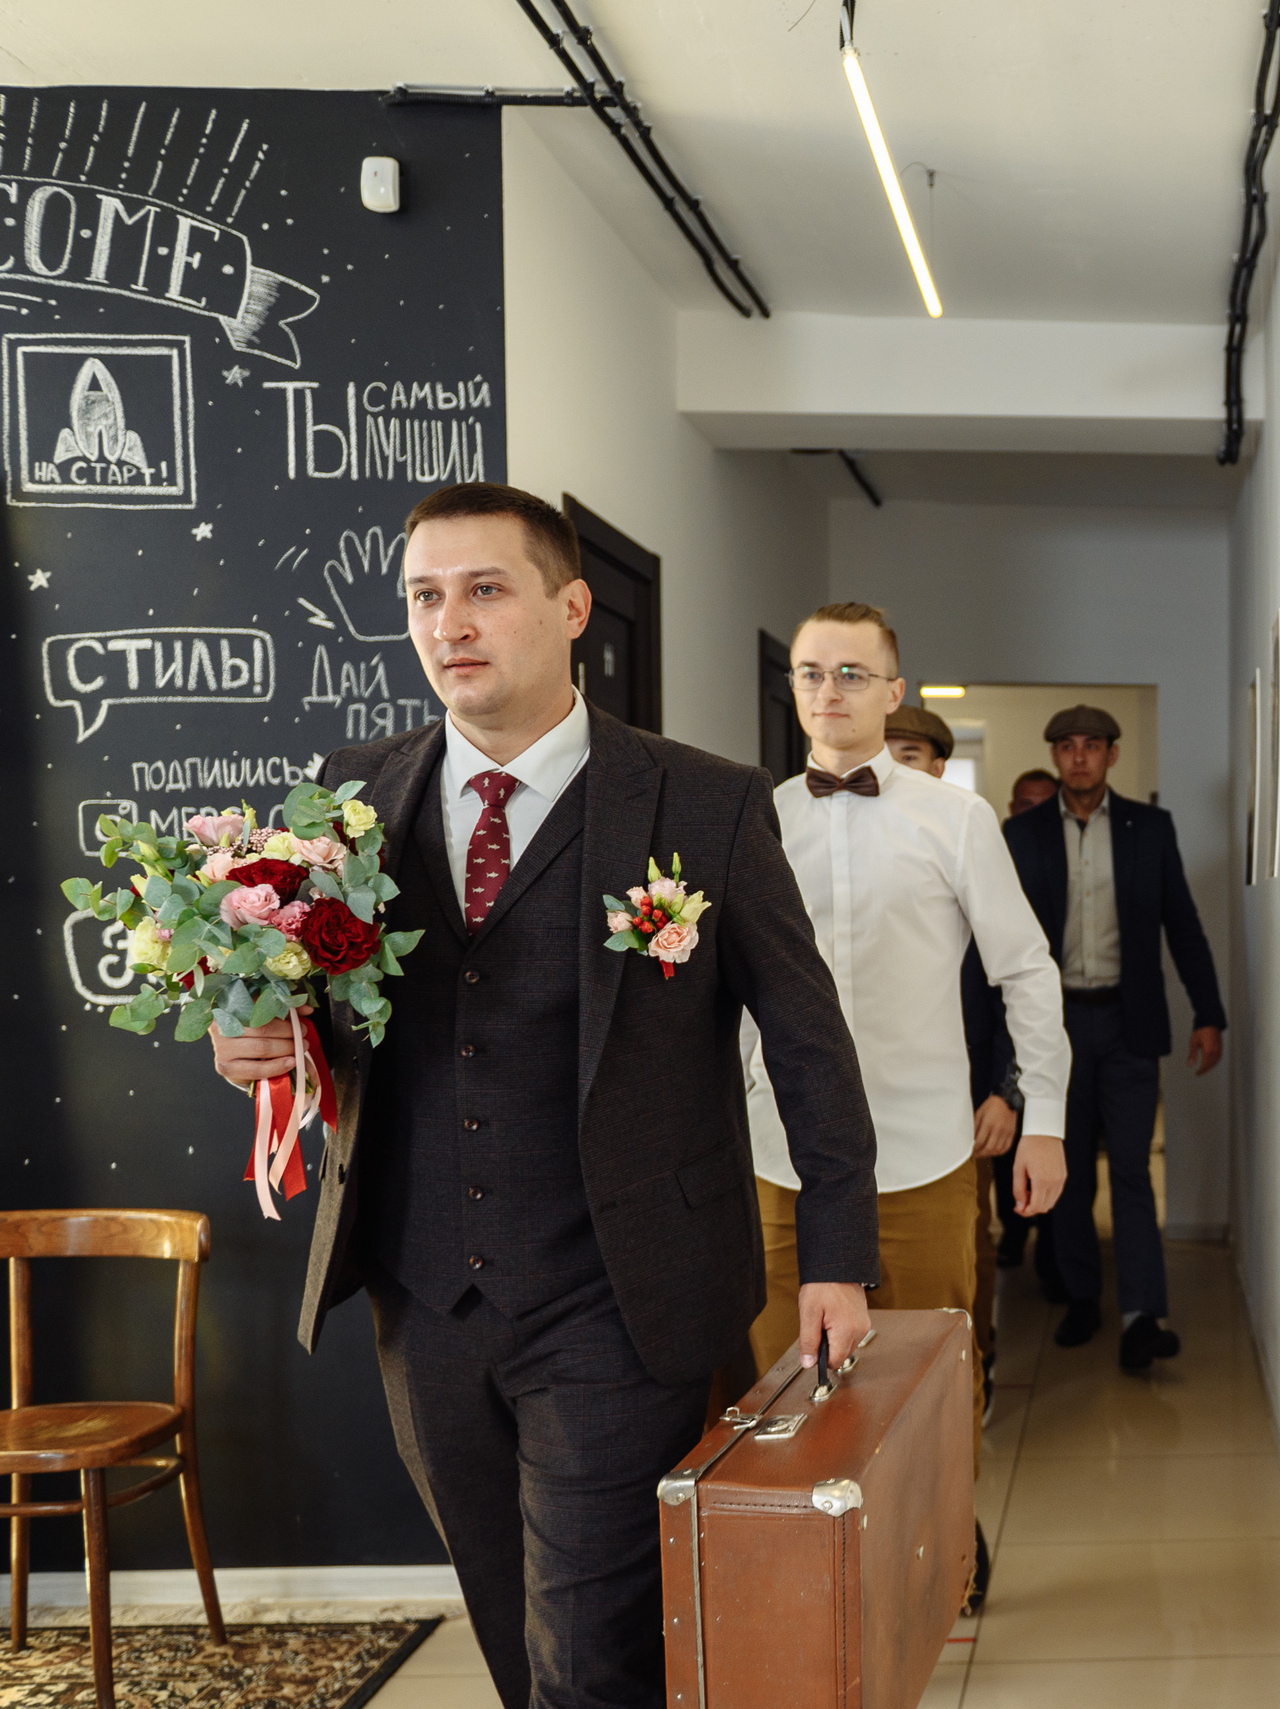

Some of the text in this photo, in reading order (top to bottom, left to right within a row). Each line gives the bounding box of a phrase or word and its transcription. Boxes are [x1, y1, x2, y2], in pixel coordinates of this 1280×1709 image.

[262, 374, 491, 481] ТЫ САМЫЙ
[364, 414, 485, 484] ЛУЧШИЙ
[34, 461, 62, 484] НА
[67, 638, 264, 694] СТИЛЬ!
[132, 756, 303, 792] ПОДПИШИСЬ
